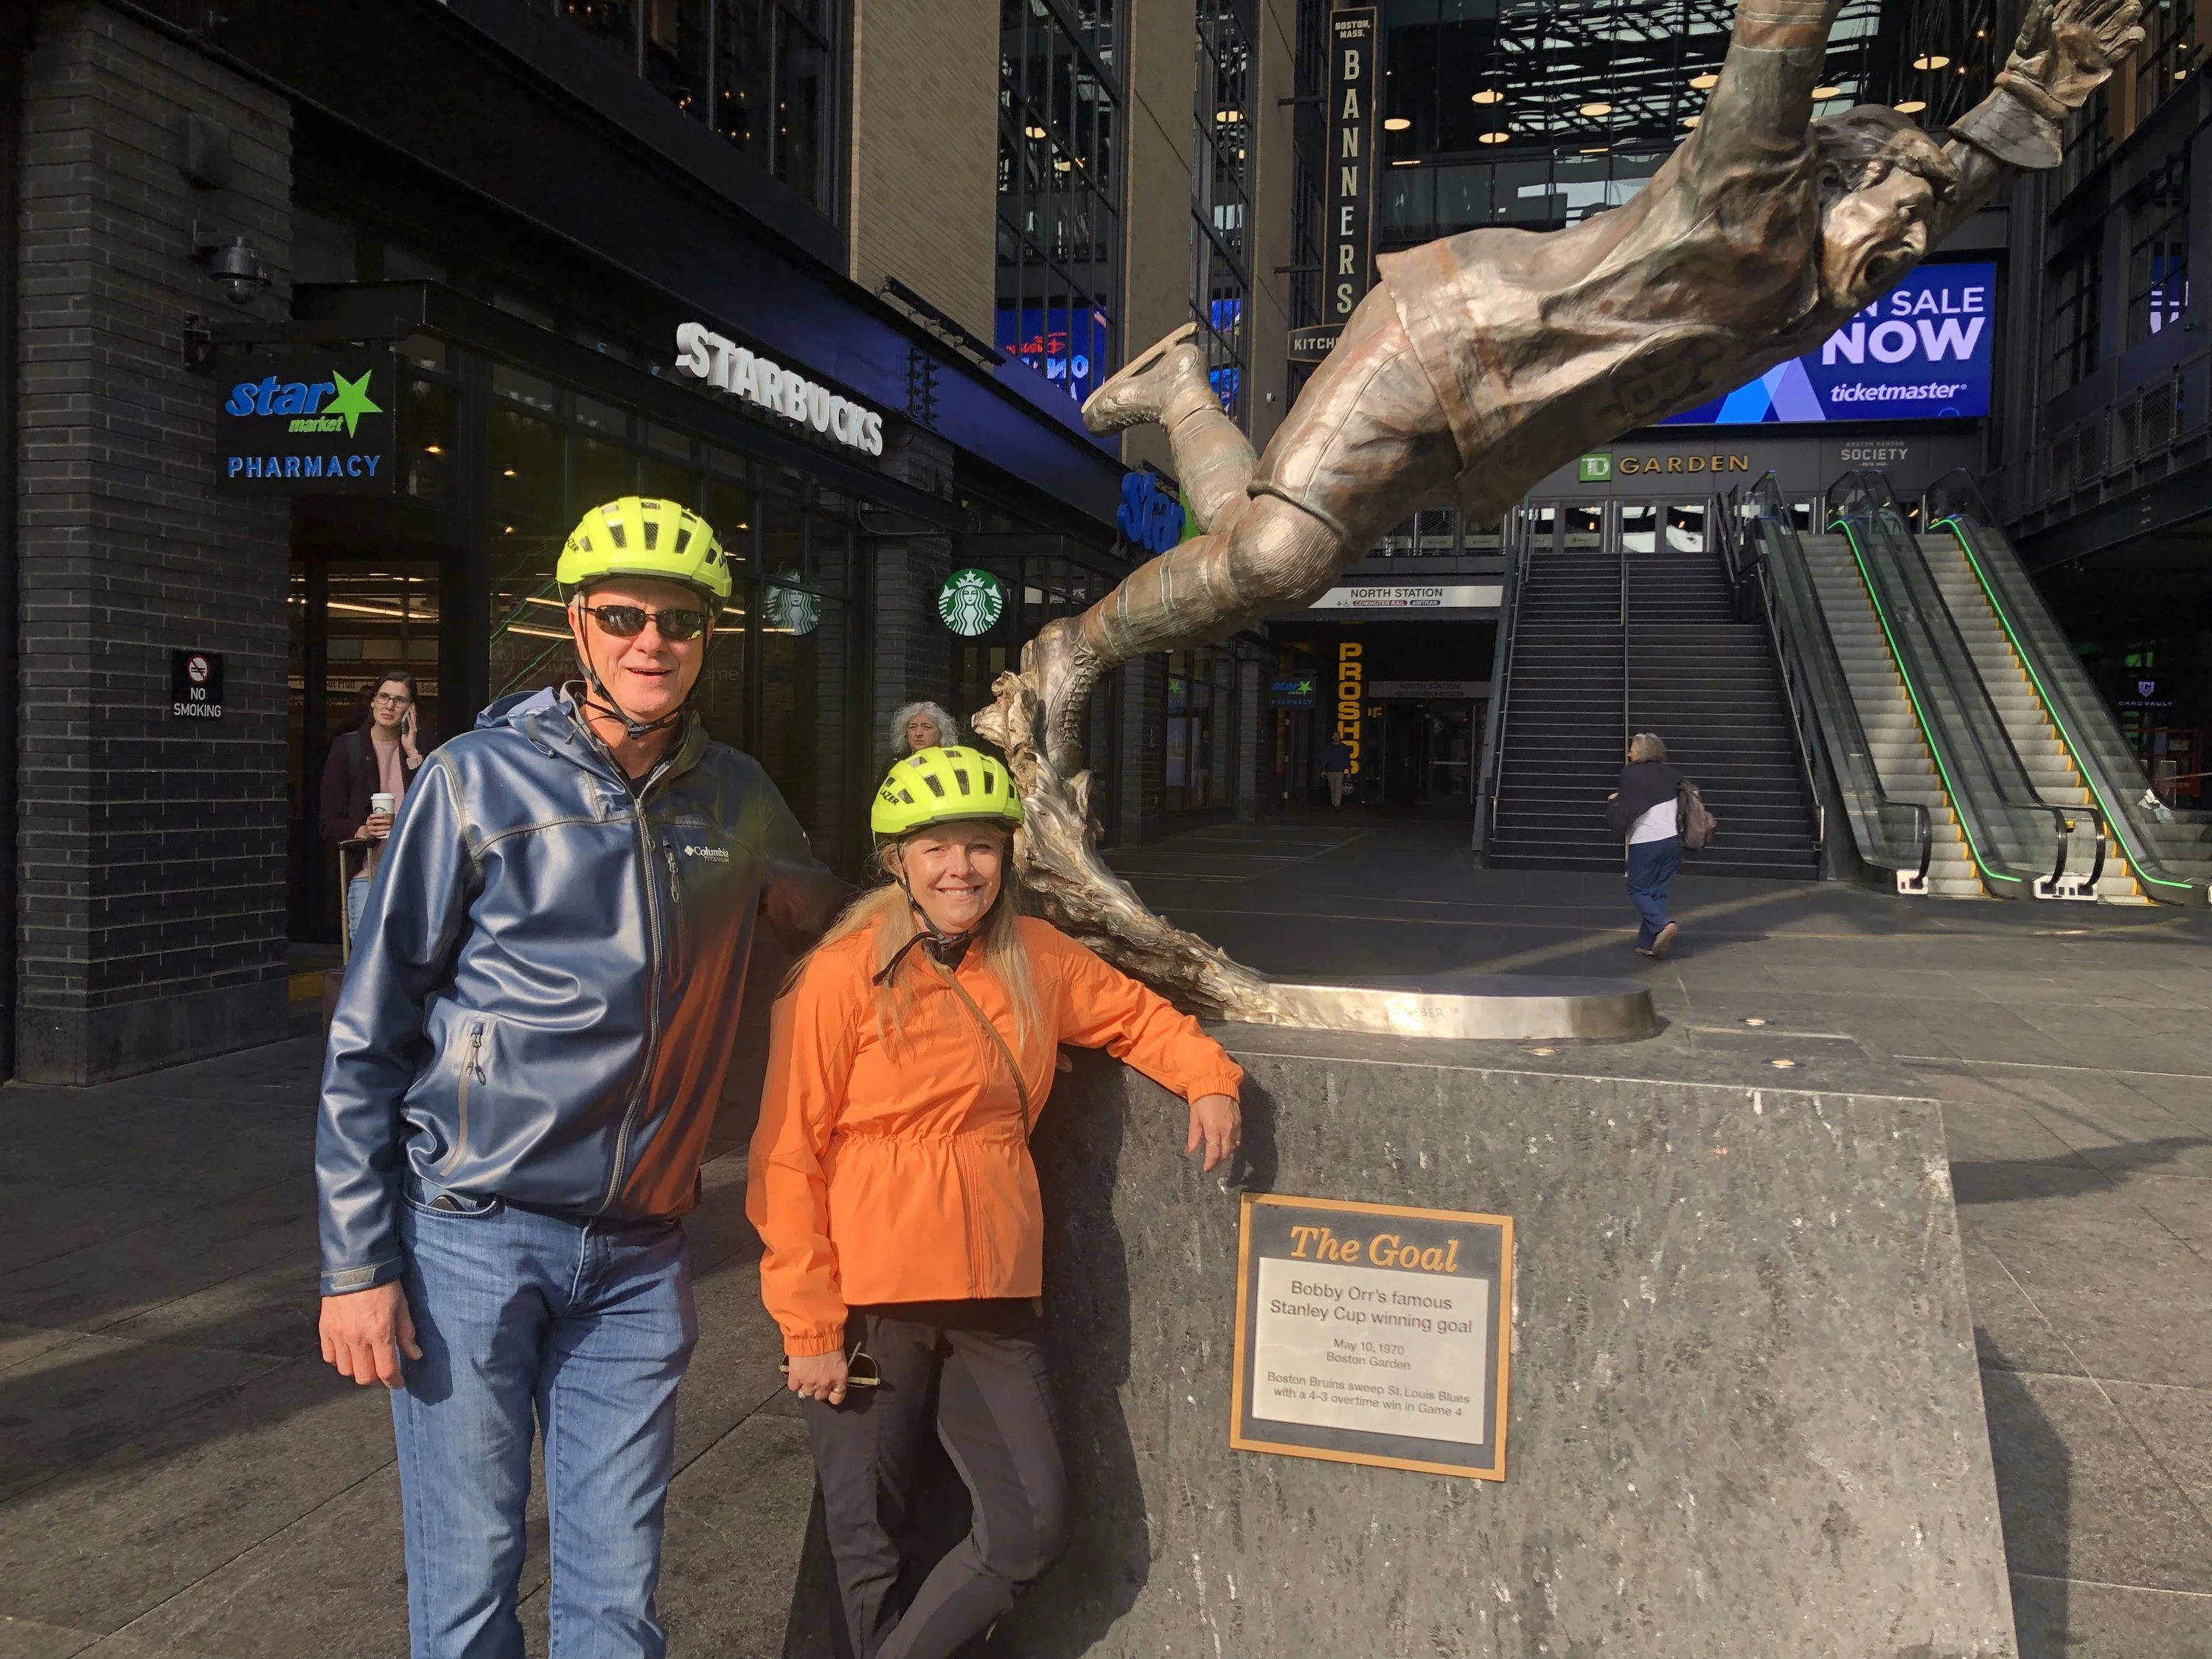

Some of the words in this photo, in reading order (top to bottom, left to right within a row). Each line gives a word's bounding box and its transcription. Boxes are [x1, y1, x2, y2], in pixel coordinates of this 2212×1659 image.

[1340, 29, 1366, 39] MASS.
[1336, 49, 1360, 314] BANNERS
[1891, 287, 1985, 316] SALE
[1294, 337, 1338, 351] KITCH
[1822, 317, 1986, 366] NOW
[225, 375, 335, 417] star
[675, 322, 883, 456] STARBUCKS
[288, 416, 344, 433] market
[1582, 457, 1610, 476] TD
[1618, 454, 1749, 474] GARDEN
[1840, 448, 1908, 461] SOCIETY
[228, 455, 380, 478] PHARMACY
[1351, 589, 1391, 598] NORTH
[1394, 588, 1443, 597] STATION
[190, 686, 206, 700] NO
[173, 703, 221, 717] SMOKING
[880, 787, 900, 806] LAZER
[694, 846, 729, 858] Columbia
[1290, 1225, 1361, 1263] The
[1368, 1234, 1459, 1273] Goal
[1291, 1280, 1343, 1301] Bobby
[1348, 1286, 1387, 1303] Orr's
[1392, 1291, 1453, 1310] famous
[1270, 1300, 1329, 1321] Stanley
[1334, 1307, 1366, 1325] Cup
[1371, 1312, 1431, 1332] winning
[1436, 1320, 1472, 1334] goal
[1333, 1338, 1356, 1352] May
[1360, 1341, 1376, 1354] 10,
[1379, 1343, 1405, 1355] 1970
[1326, 1352, 1366, 1366] Boston
[1369, 1357, 1411, 1370] Garden
[1267, 1371, 1306, 1385] Boston
[1309, 1377, 1345, 1391] Bruins
[1348, 1382, 1384, 1395] sweep
[1388, 1385, 1402, 1397] St.
[1404, 1388, 1435, 1400] Louis
[1438, 1391, 1470, 1405] Blues
[1273, 1388, 1295, 1399] with
[1309, 1392, 1328, 1402] 4-3
[1331, 1394, 1380, 1408] overtime
[1382, 1399, 1402, 1410] win
[1405, 1401, 1415, 1411] in
[1418, 1403, 1452, 1416] Game
[1455, 1407, 1462, 1416] 4
